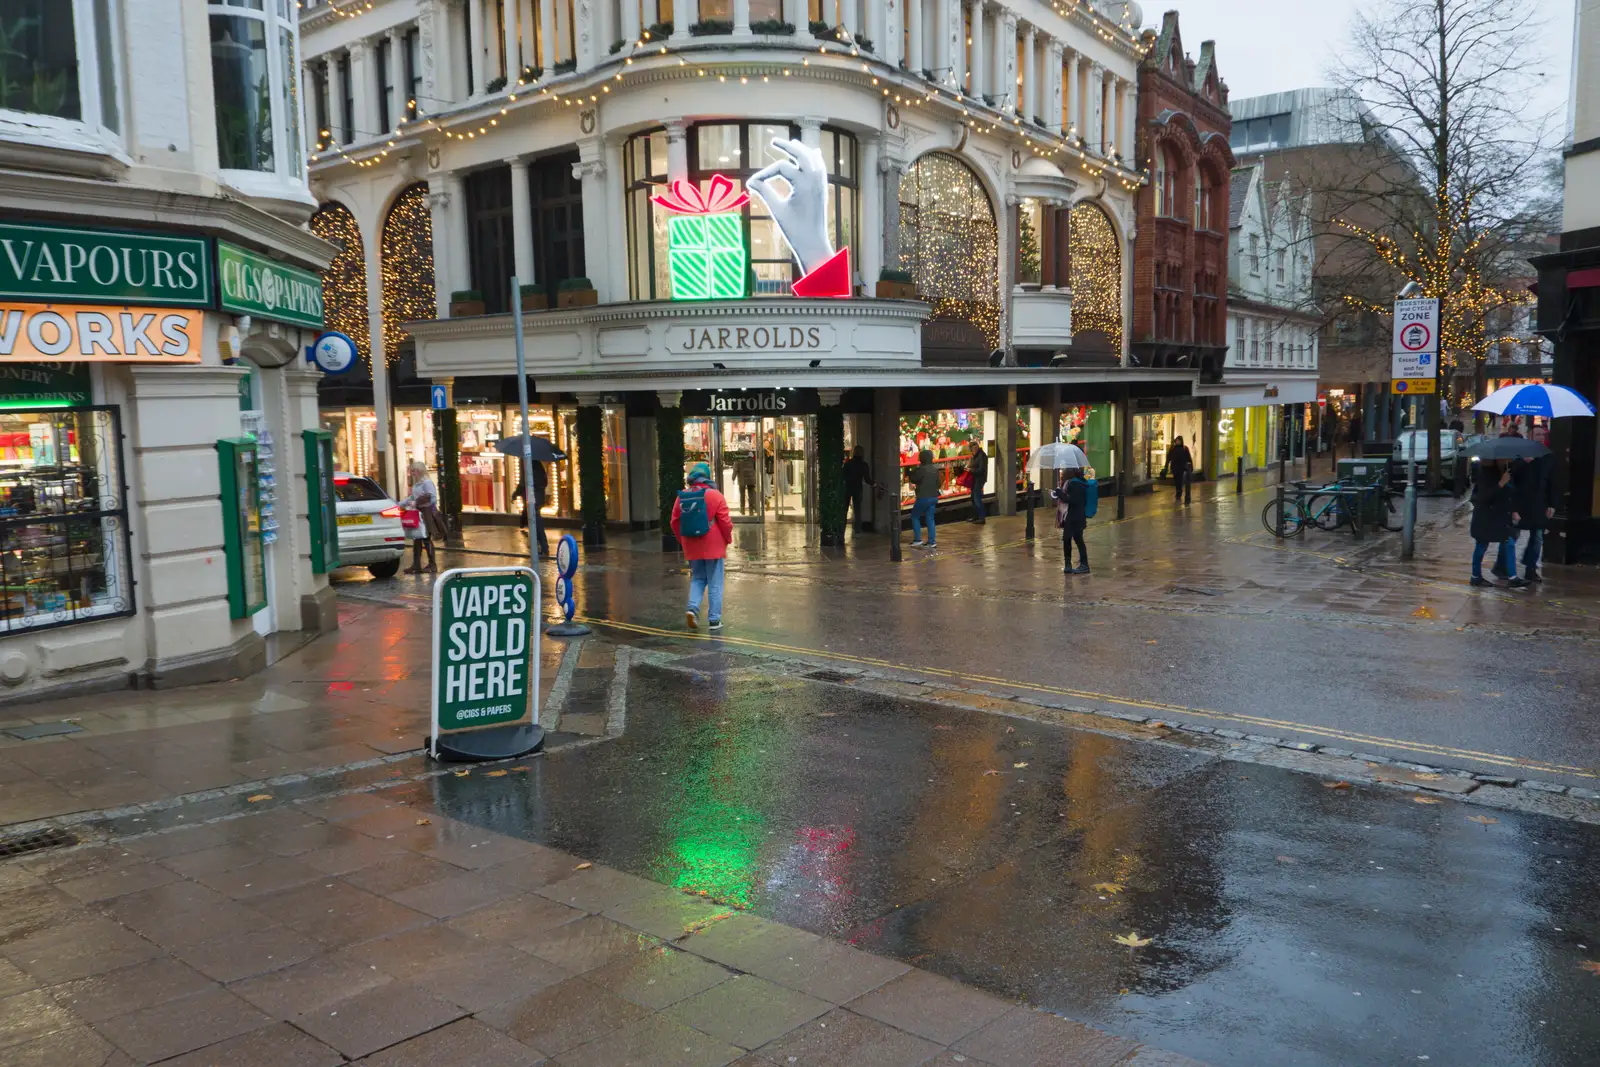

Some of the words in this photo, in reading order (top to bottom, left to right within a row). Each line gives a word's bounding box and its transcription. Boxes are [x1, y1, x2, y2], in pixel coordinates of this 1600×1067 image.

[1, 239, 199, 289] VAPOURS
[223, 258, 262, 303] CIGS
[273, 274, 321, 317] PAPERS
[1401, 312, 1430, 321] ZONE
[683, 327, 821, 350] JARROLDS
[33, 391, 86, 402] DRINKS
[707, 393, 787, 412] Jarrolds
[450, 583, 527, 618] VAPES
[448, 617, 526, 662] SOLD
[446, 658, 524, 704] HERE
[456, 707, 480, 720] @CIGS
[480, 708, 486, 717] &
[487, 704, 512, 716] PAPERS
